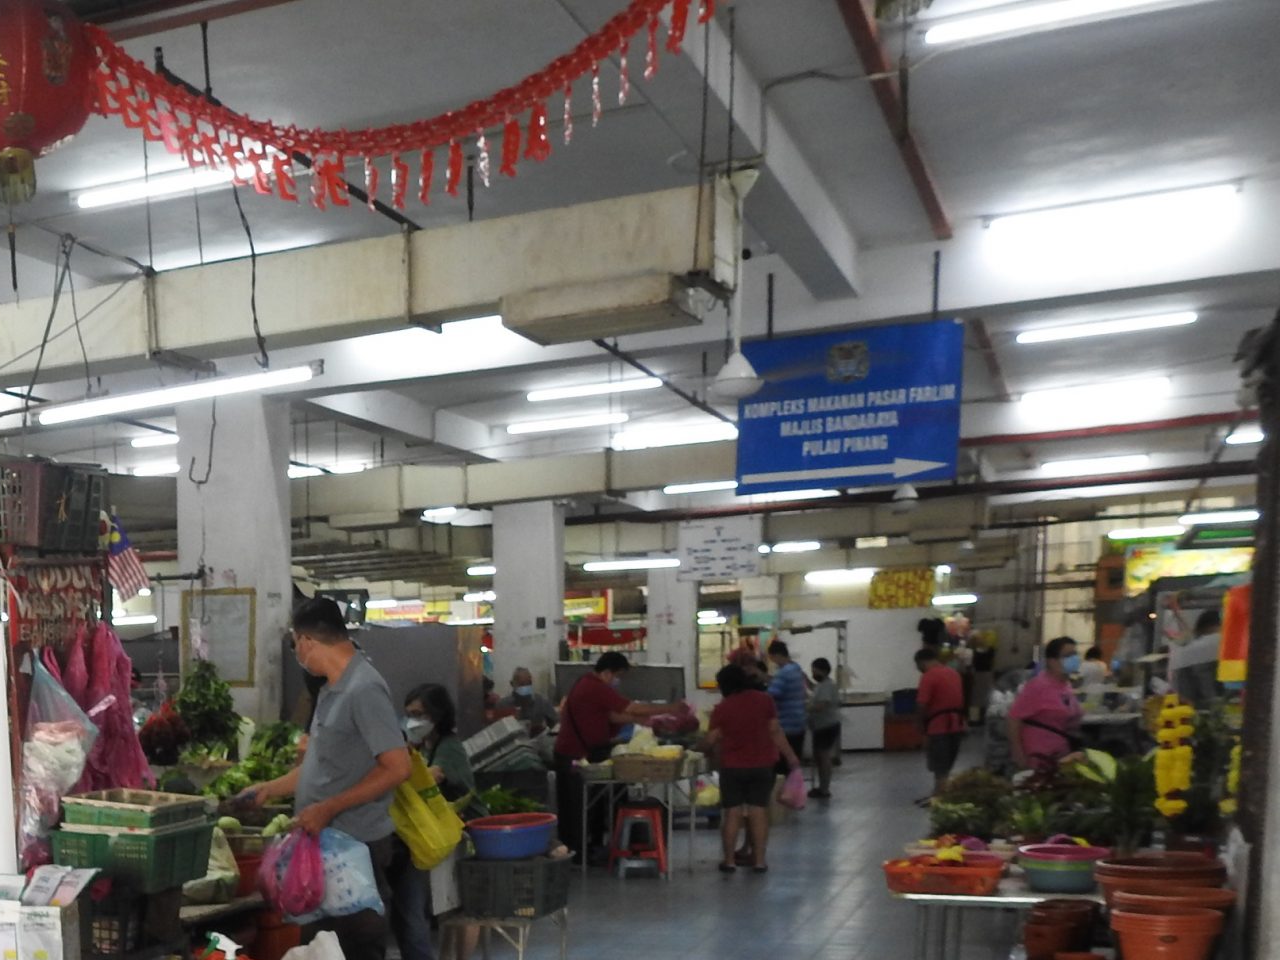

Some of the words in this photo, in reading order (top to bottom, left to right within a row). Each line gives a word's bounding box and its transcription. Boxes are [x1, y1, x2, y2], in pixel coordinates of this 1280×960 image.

[744, 399, 805, 419] KOMPLEKS
[807, 393, 865, 412] MAKANAN
[867, 389, 907, 407] PASAR
[909, 384, 956, 403] FARLIM
[780, 418, 824, 437] MAJLIS
[825, 410, 899, 433] BANDARAYA
[802, 438, 842, 456] PULAU
[843, 434, 889, 452] PINANG
